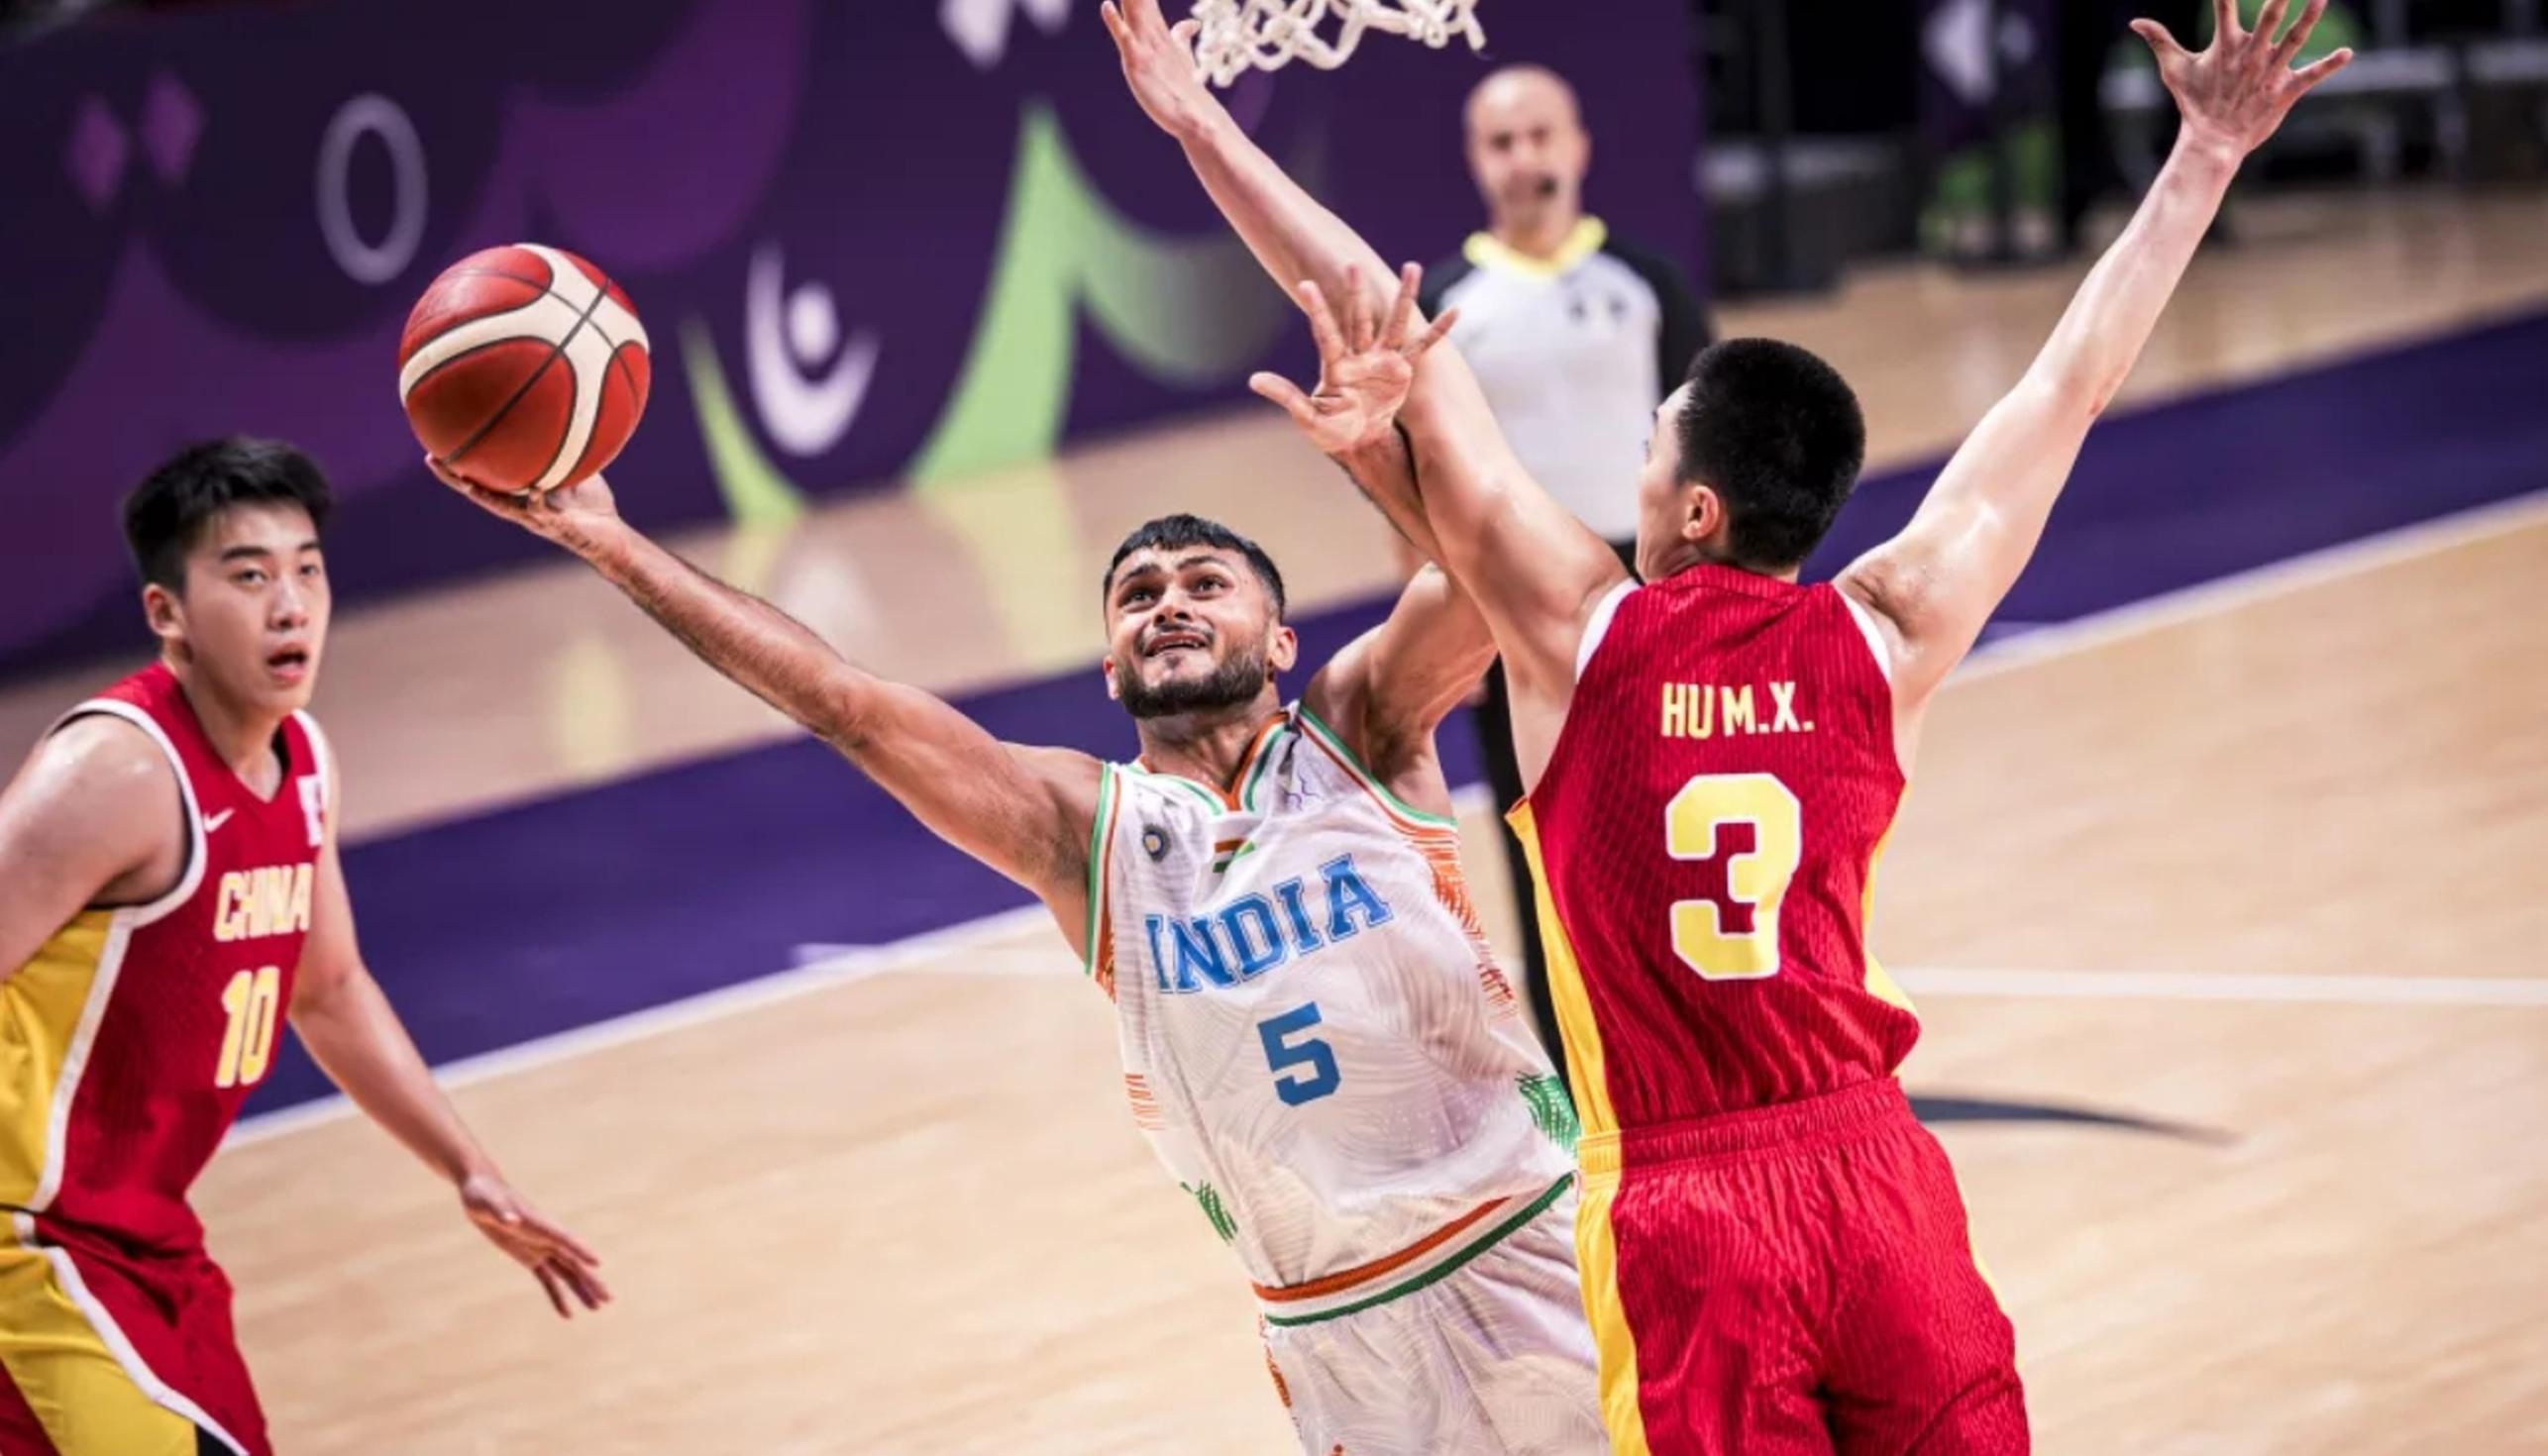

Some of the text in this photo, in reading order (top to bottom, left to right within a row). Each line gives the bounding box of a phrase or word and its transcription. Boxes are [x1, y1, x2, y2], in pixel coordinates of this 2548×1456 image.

[1660, 680, 1815, 739] HU M.X.
[213, 862, 314, 942] CHINA
[1143, 853, 1394, 994] INDIA
[1665, 773, 1801, 981] 3
[214, 964, 281, 1089] 10
[1257, 1000, 1341, 1106] 5
